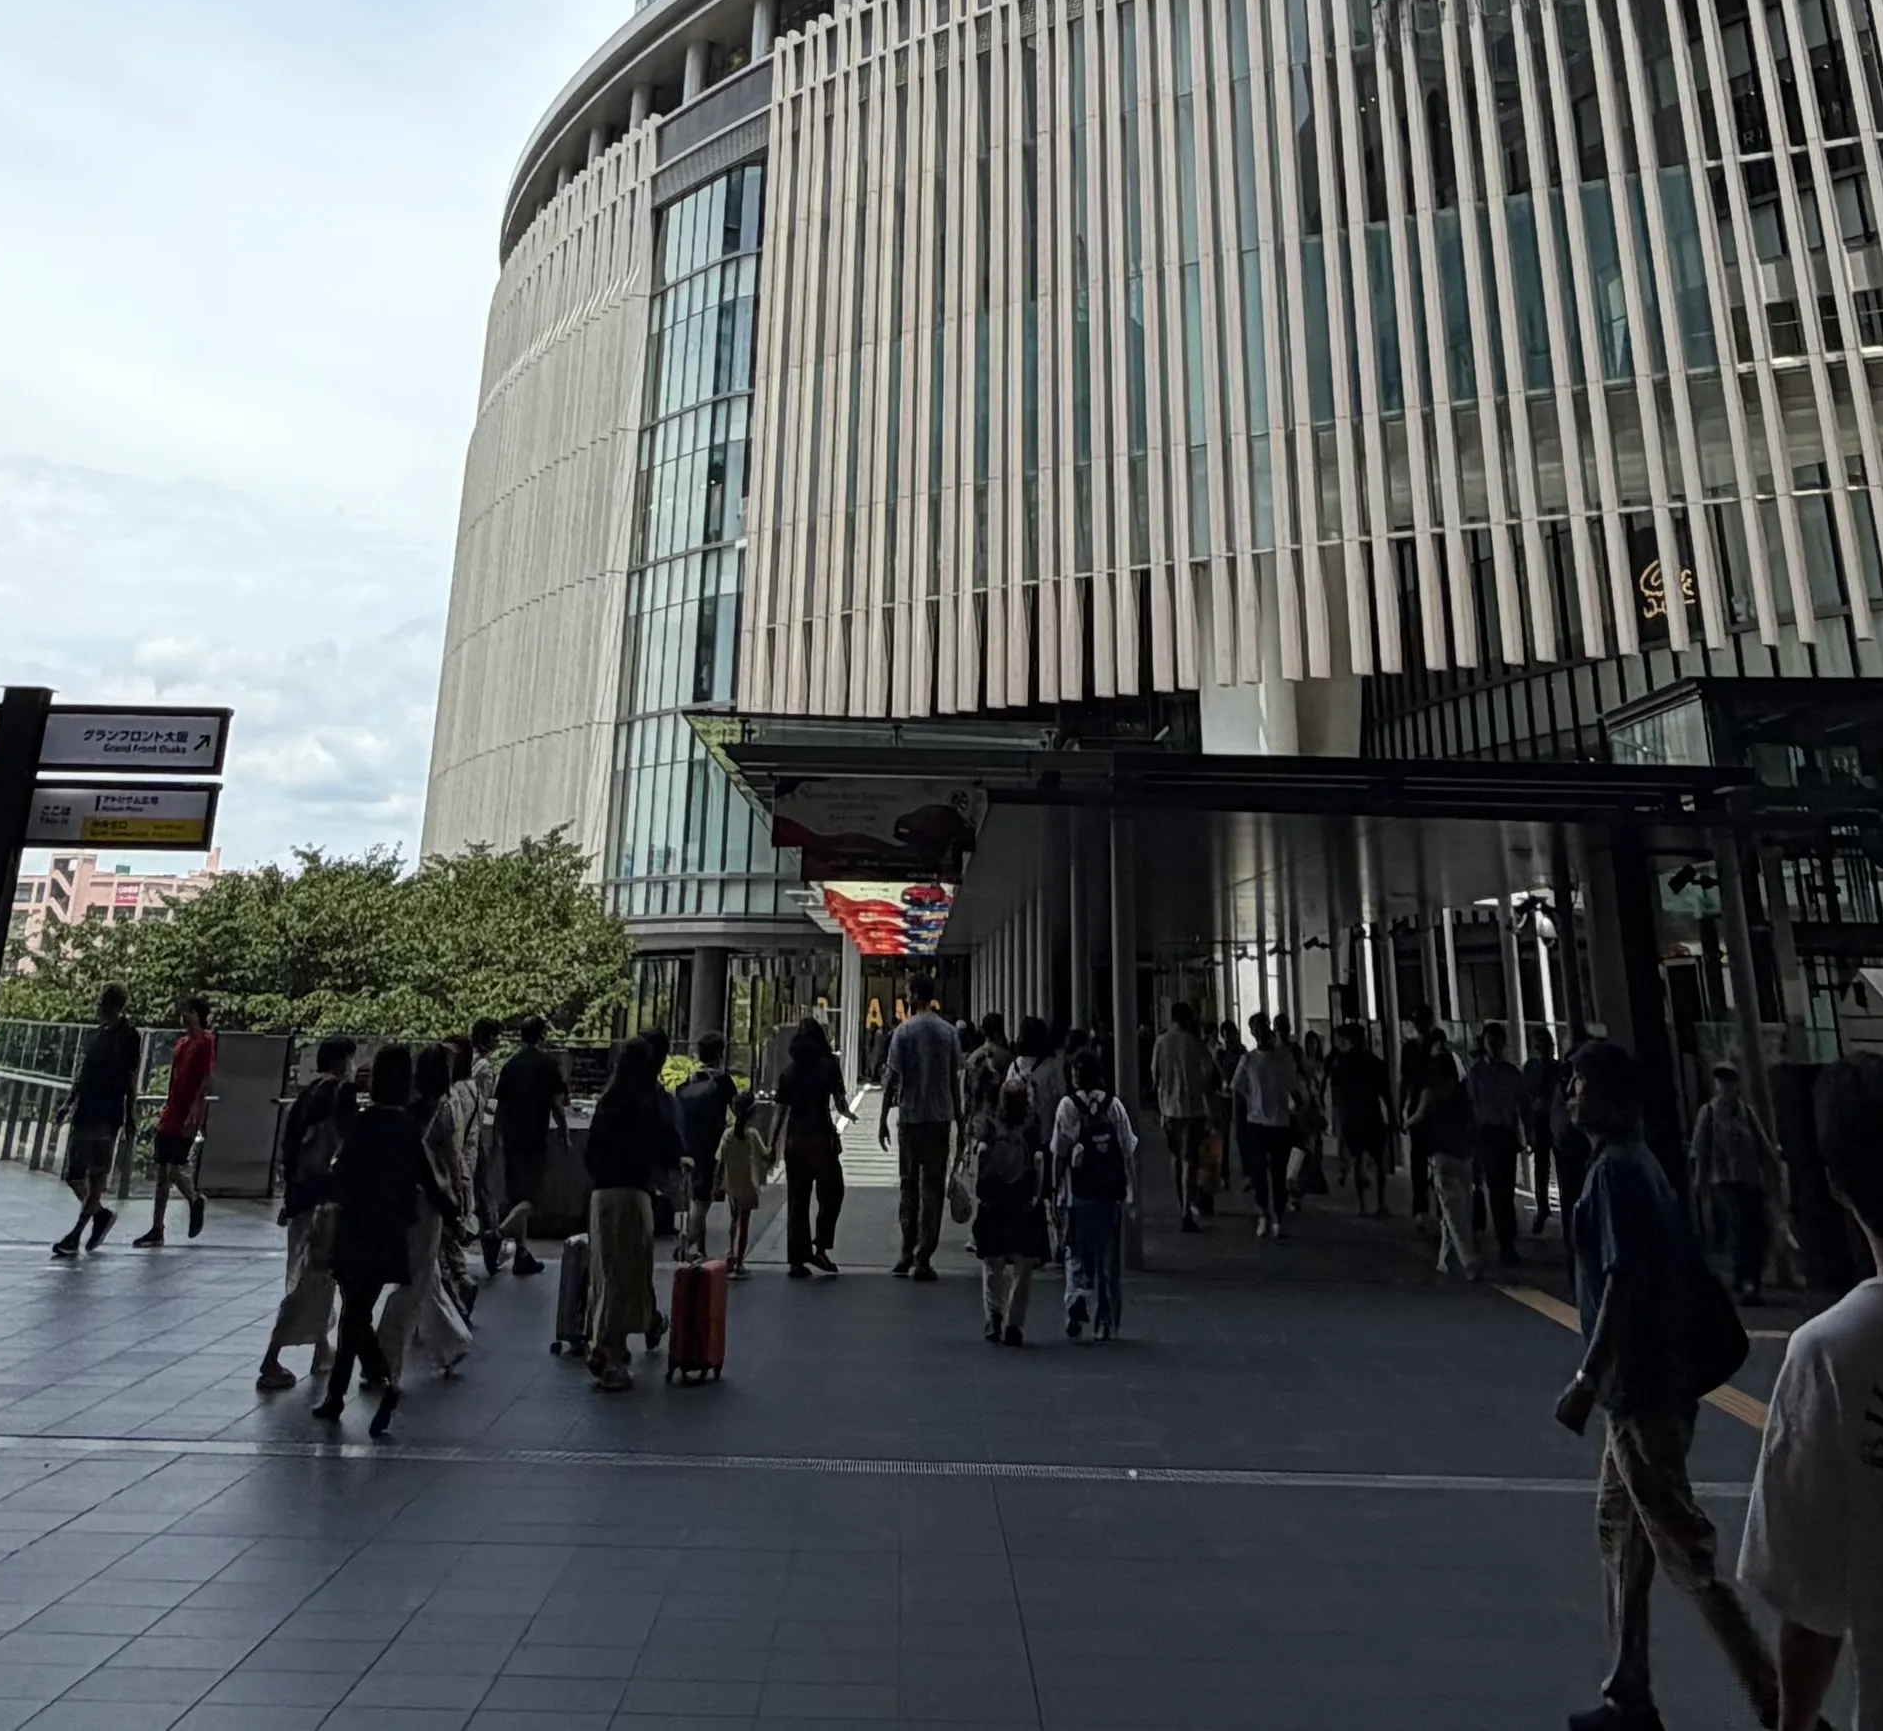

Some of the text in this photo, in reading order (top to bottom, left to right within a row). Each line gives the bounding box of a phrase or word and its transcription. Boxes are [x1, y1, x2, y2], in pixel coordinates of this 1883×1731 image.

[83, 730, 188, 743] グランフロント大阪
